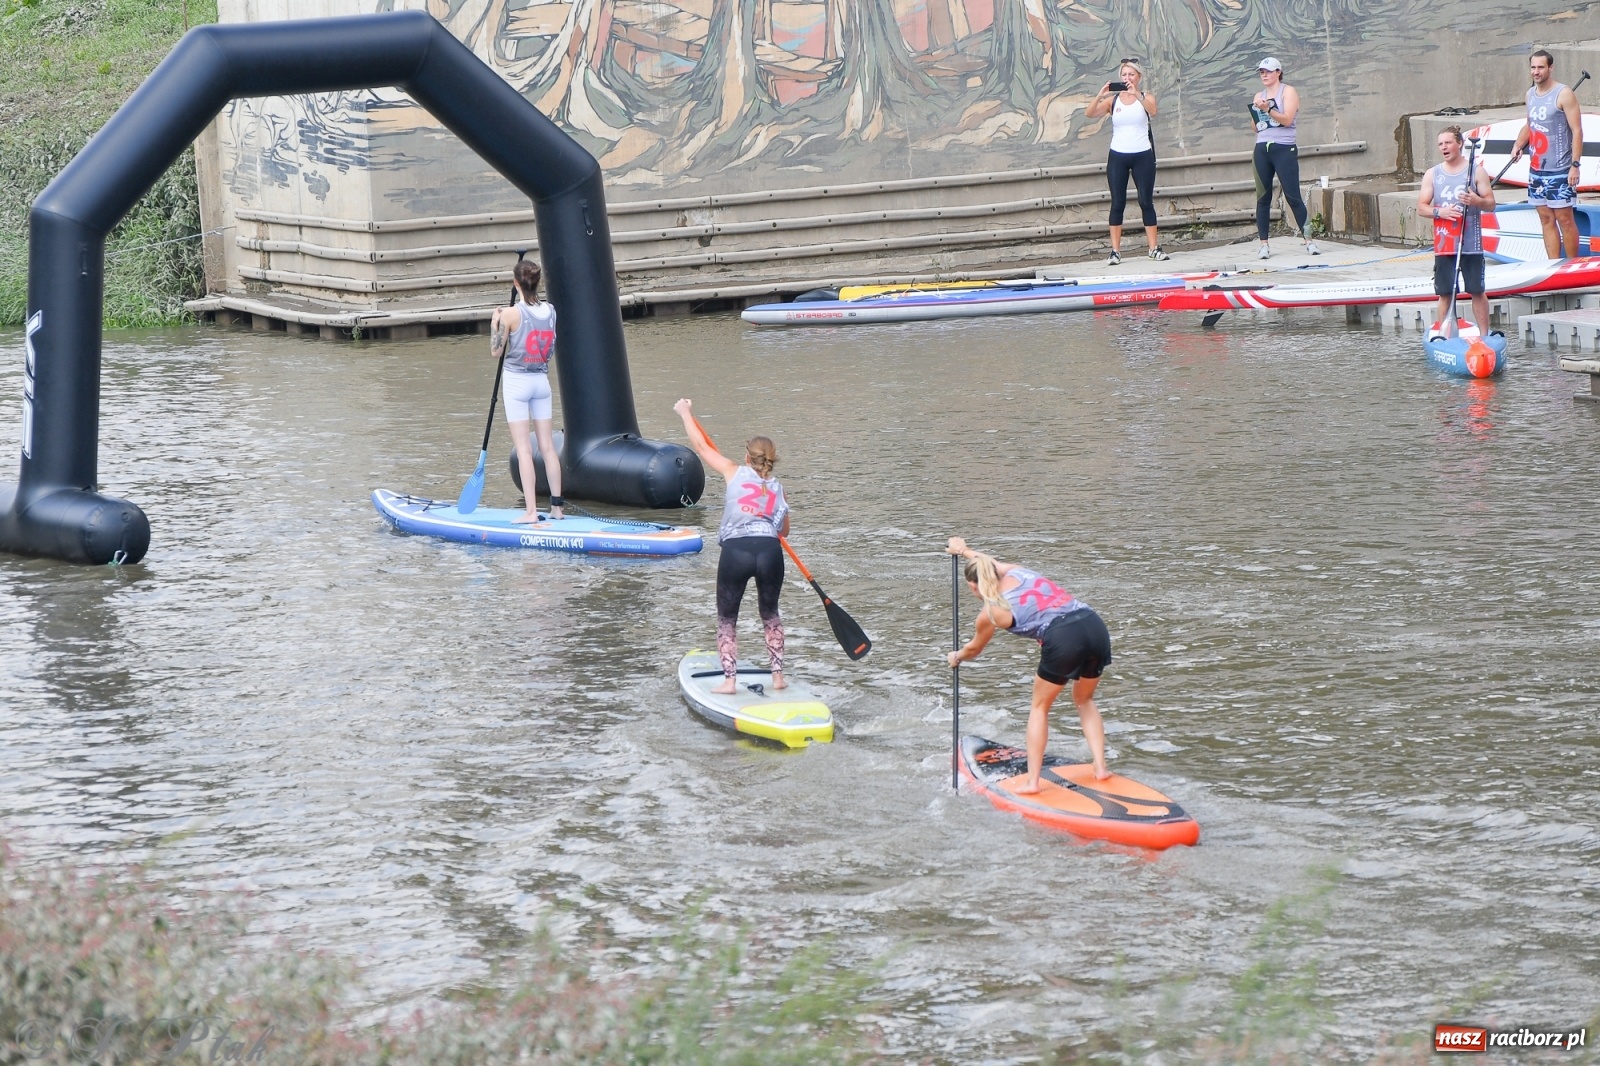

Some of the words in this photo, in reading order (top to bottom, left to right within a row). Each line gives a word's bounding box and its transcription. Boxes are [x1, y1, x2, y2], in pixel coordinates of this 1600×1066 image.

[1529, 105, 1547, 121] 48
[1440, 184, 1466, 201] 46
[525, 329, 554, 356] 67
[737, 482, 777, 516] 21
[519, 534, 570, 549] COMPETITION
[1018, 577, 1066, 612] 22
